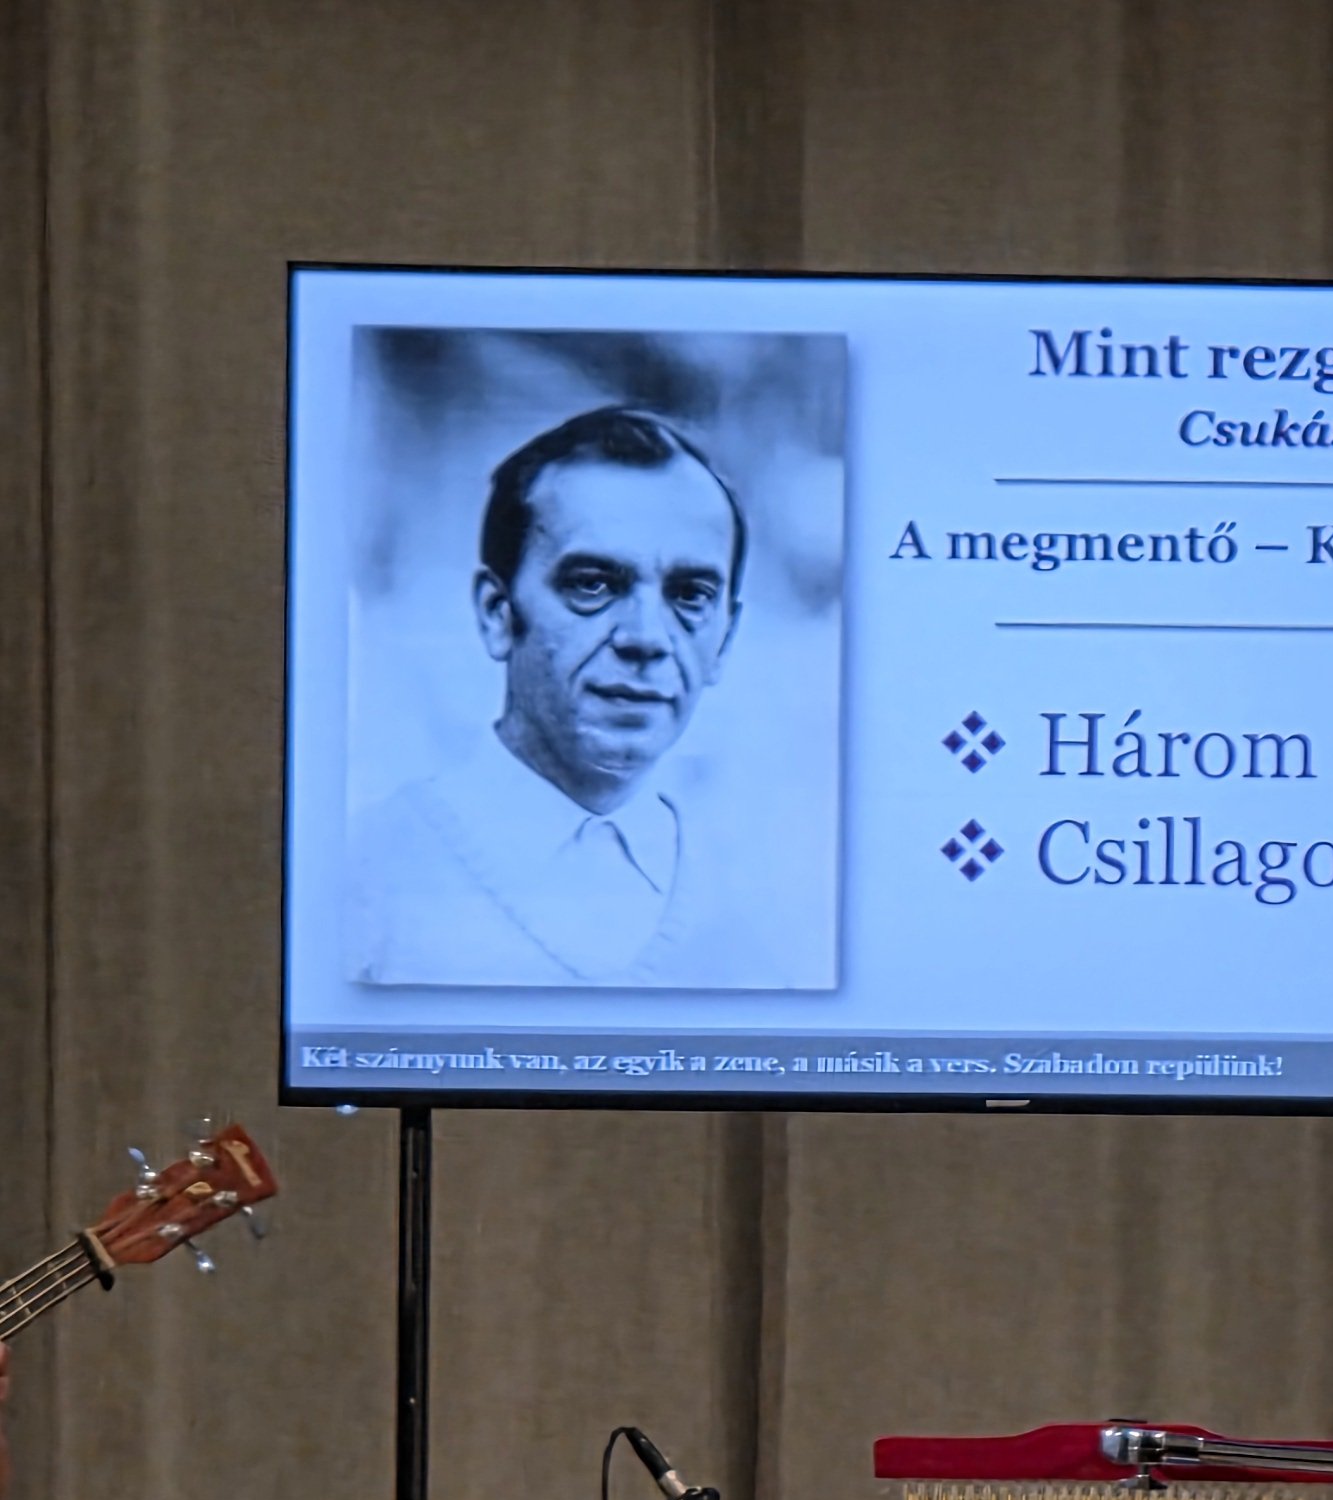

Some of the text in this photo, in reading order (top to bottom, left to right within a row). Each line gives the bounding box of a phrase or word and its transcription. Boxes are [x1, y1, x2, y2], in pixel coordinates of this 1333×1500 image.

[1028, 327, 1190, 379] Mint
[888, 520, 932, 560] A
[946, 521, 1238, 572] megmentő
[1039, 708, 1317, 780] Három
[301, 1046, 347, 1068] Két
[511, 1053, 568, 1073] van,
[574, 1053, 606, 1071] az
[614, 1050, 684, 1076] egyik
[690, 1055, 704, 1072] a
[714, 1055, 785, 1076] zene,
[793, 1055, 807, 1072] a
[817, 1050, 899, 1073] másik
[906, 1056, 924, 1074] a
[1003, 1052, 1138, 1075] Szabadon
